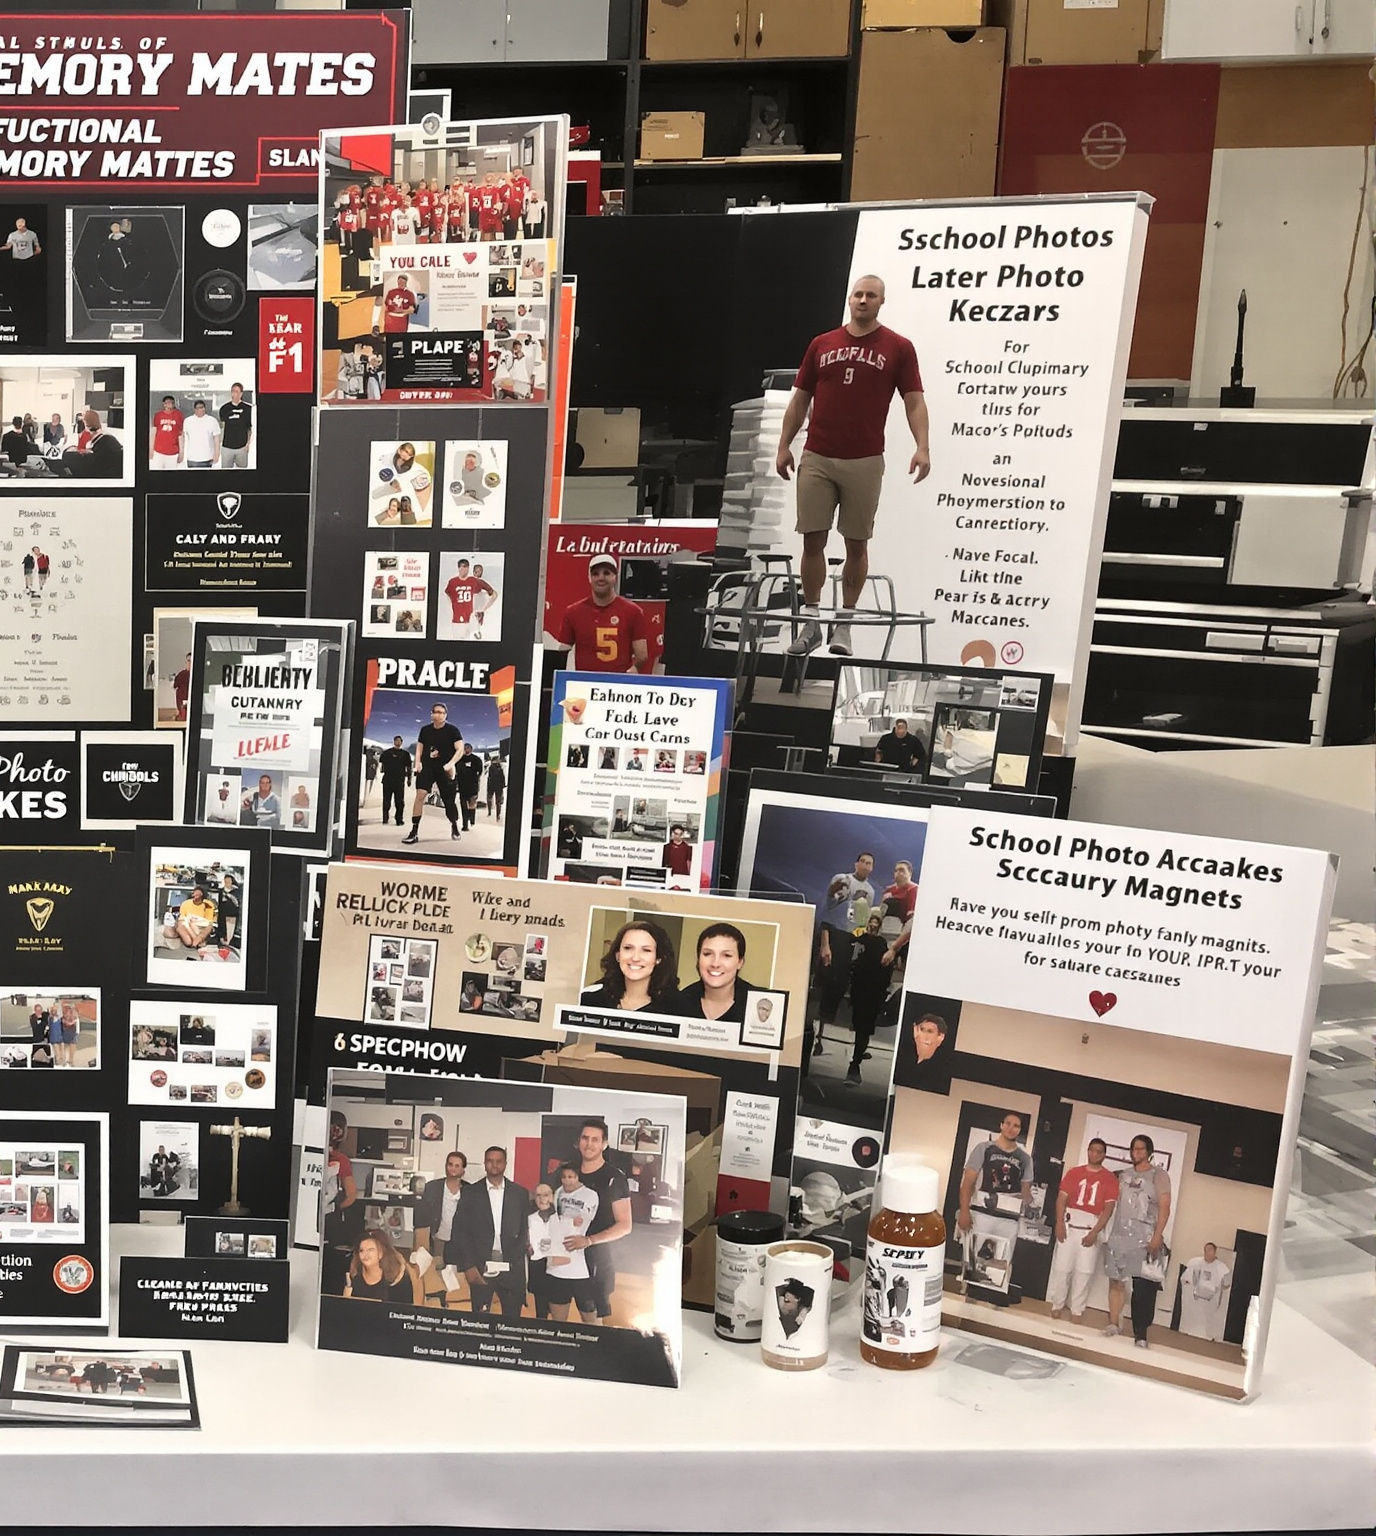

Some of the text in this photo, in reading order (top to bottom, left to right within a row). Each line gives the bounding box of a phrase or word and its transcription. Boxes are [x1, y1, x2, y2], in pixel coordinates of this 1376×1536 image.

[140, 37, 166, 50] OF
[187, 53, 375, 96] MATES
[100, 151, 235, 177] MATTES
[898, 225, 1113, 250] Sschool Photos
[912, 264, 1083, 288] Later Photo
[949, 299, 1059, 321] Keczars
[1004, 341, 1029, 353] For
[1022, 386, 1067, 398] yours
[1018, 403, 1040, 415] for
[993, 455, 1011, 464] an
[1050, 499, 1065, 510] to
[211, 535, 236, 544] AND
[596, 628, 618, 661] 5
[377, 658, 489, 690] PRACLE
[969, 827, 1283, 884] School Photo Accaakes
[1125, 875, 1243, 909] Magnets
[991, 907, 1018, 919] you
[1060, 917, 1100, 931] prom
[1025, 951, 1046, 965] for
[1085, 942, 1121, 954] your
[1243, 964, 1281, 977] your
[1077, 1179, 1099, 1207] 11
